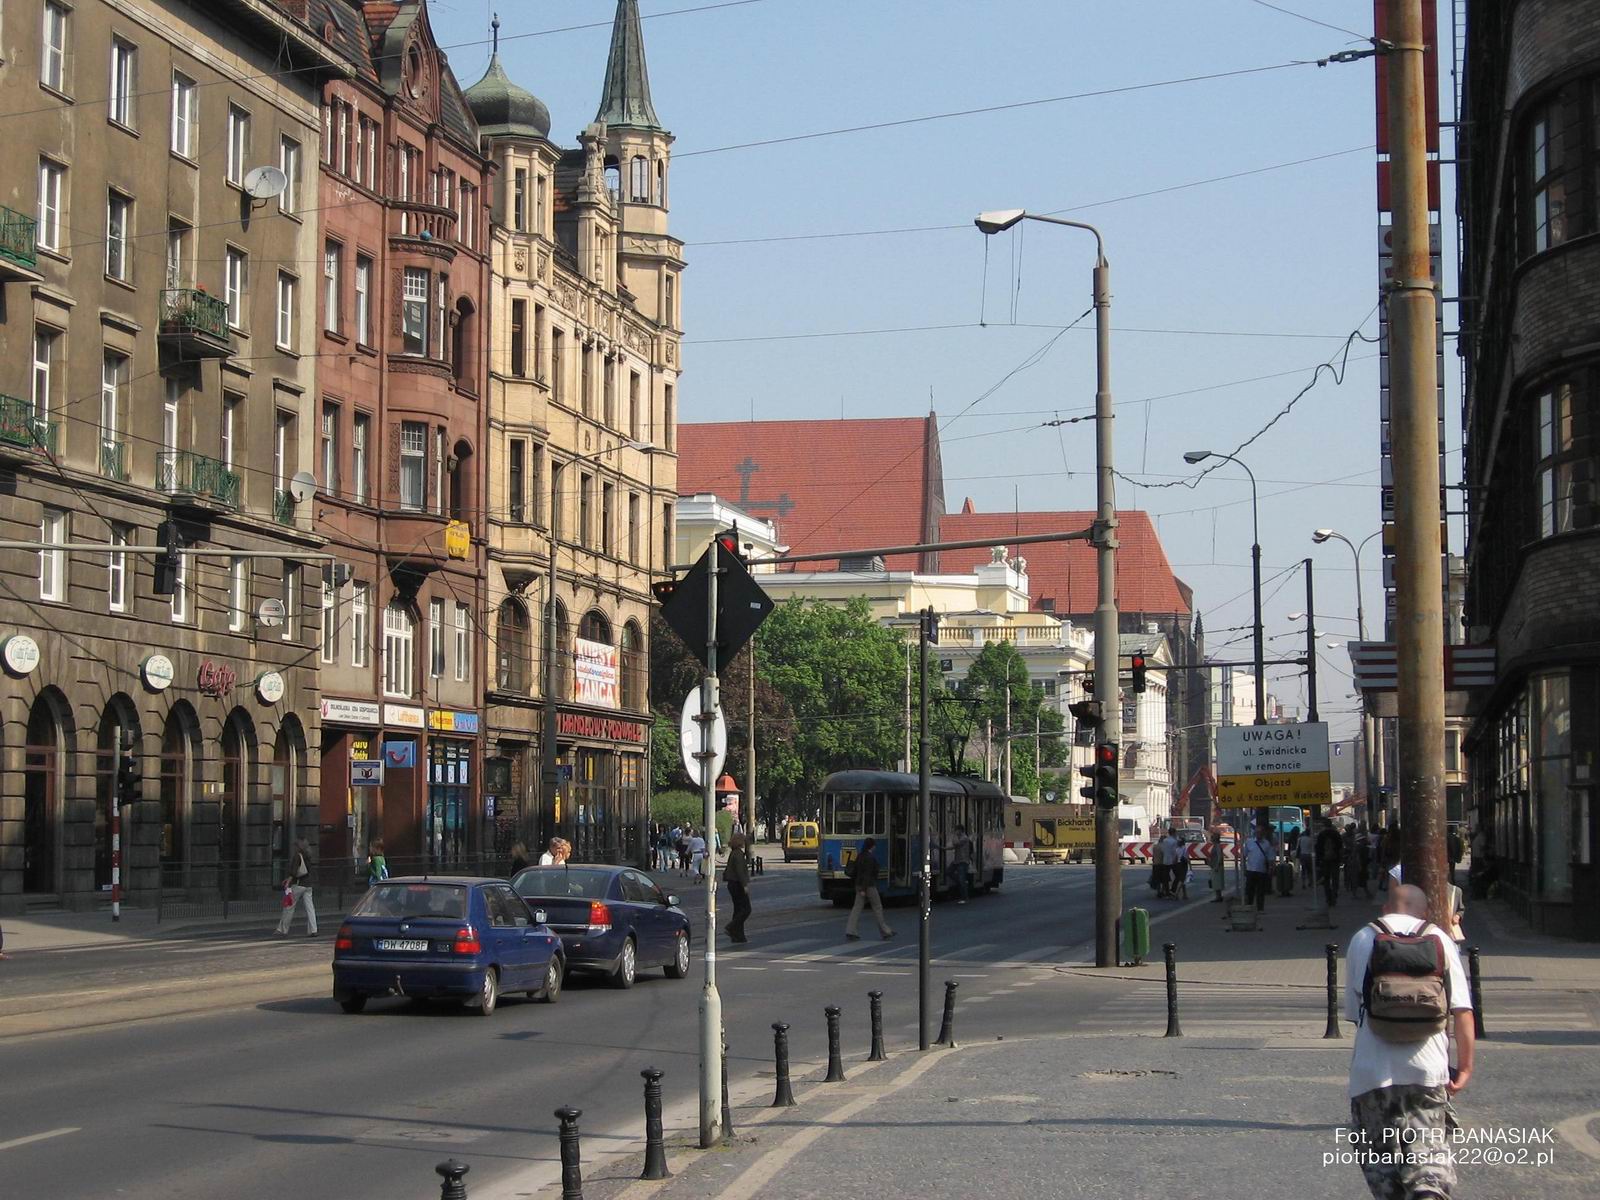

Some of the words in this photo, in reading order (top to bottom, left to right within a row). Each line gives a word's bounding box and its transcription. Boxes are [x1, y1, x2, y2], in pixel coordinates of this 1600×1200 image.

[1256, 762, 1301, 771] remoncie
[1254, 778, 1291, 789] Objazd
[1221, 794, 1232, 803] do
[383, 940, 397, 950] DW
